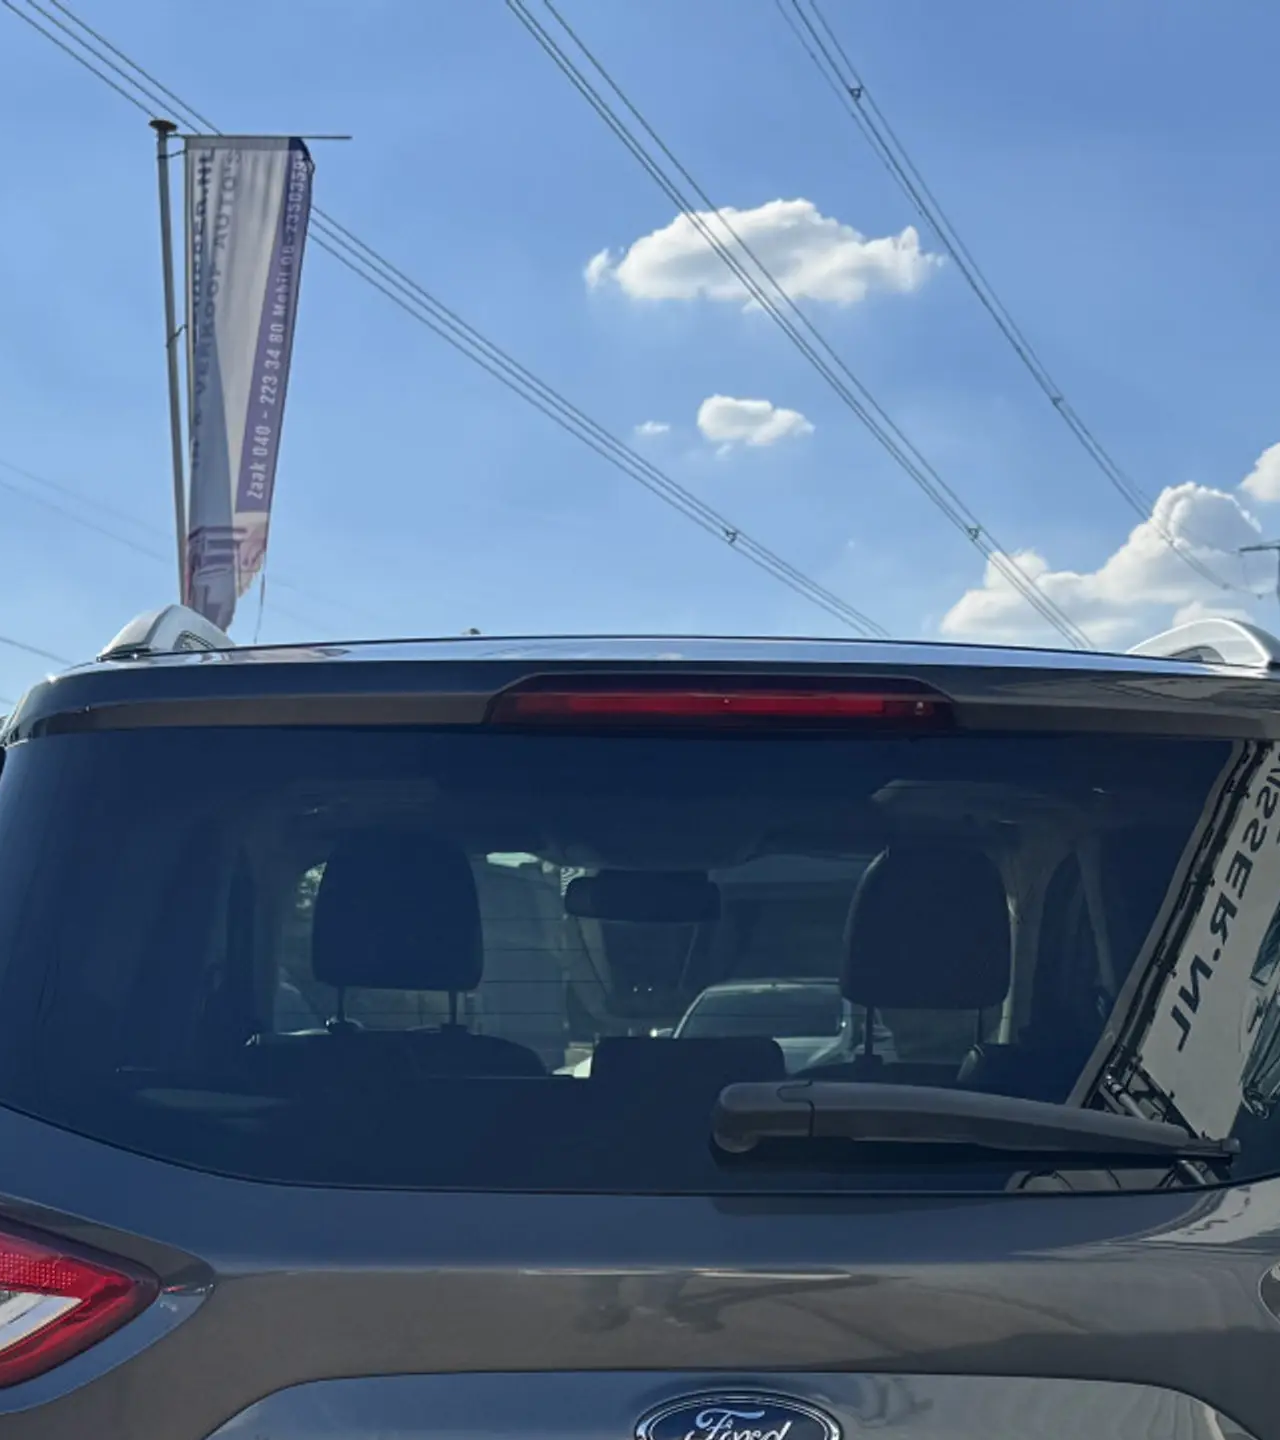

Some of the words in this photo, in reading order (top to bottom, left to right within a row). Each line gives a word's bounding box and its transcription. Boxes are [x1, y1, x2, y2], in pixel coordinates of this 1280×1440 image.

[268, 323, 284, 344] 80
[264, 348, 282, 371] 34
[260, 374, 279, 406] 223
[252, 424, 272, 457] 040
[247, 461, 267, 500] Zaak
